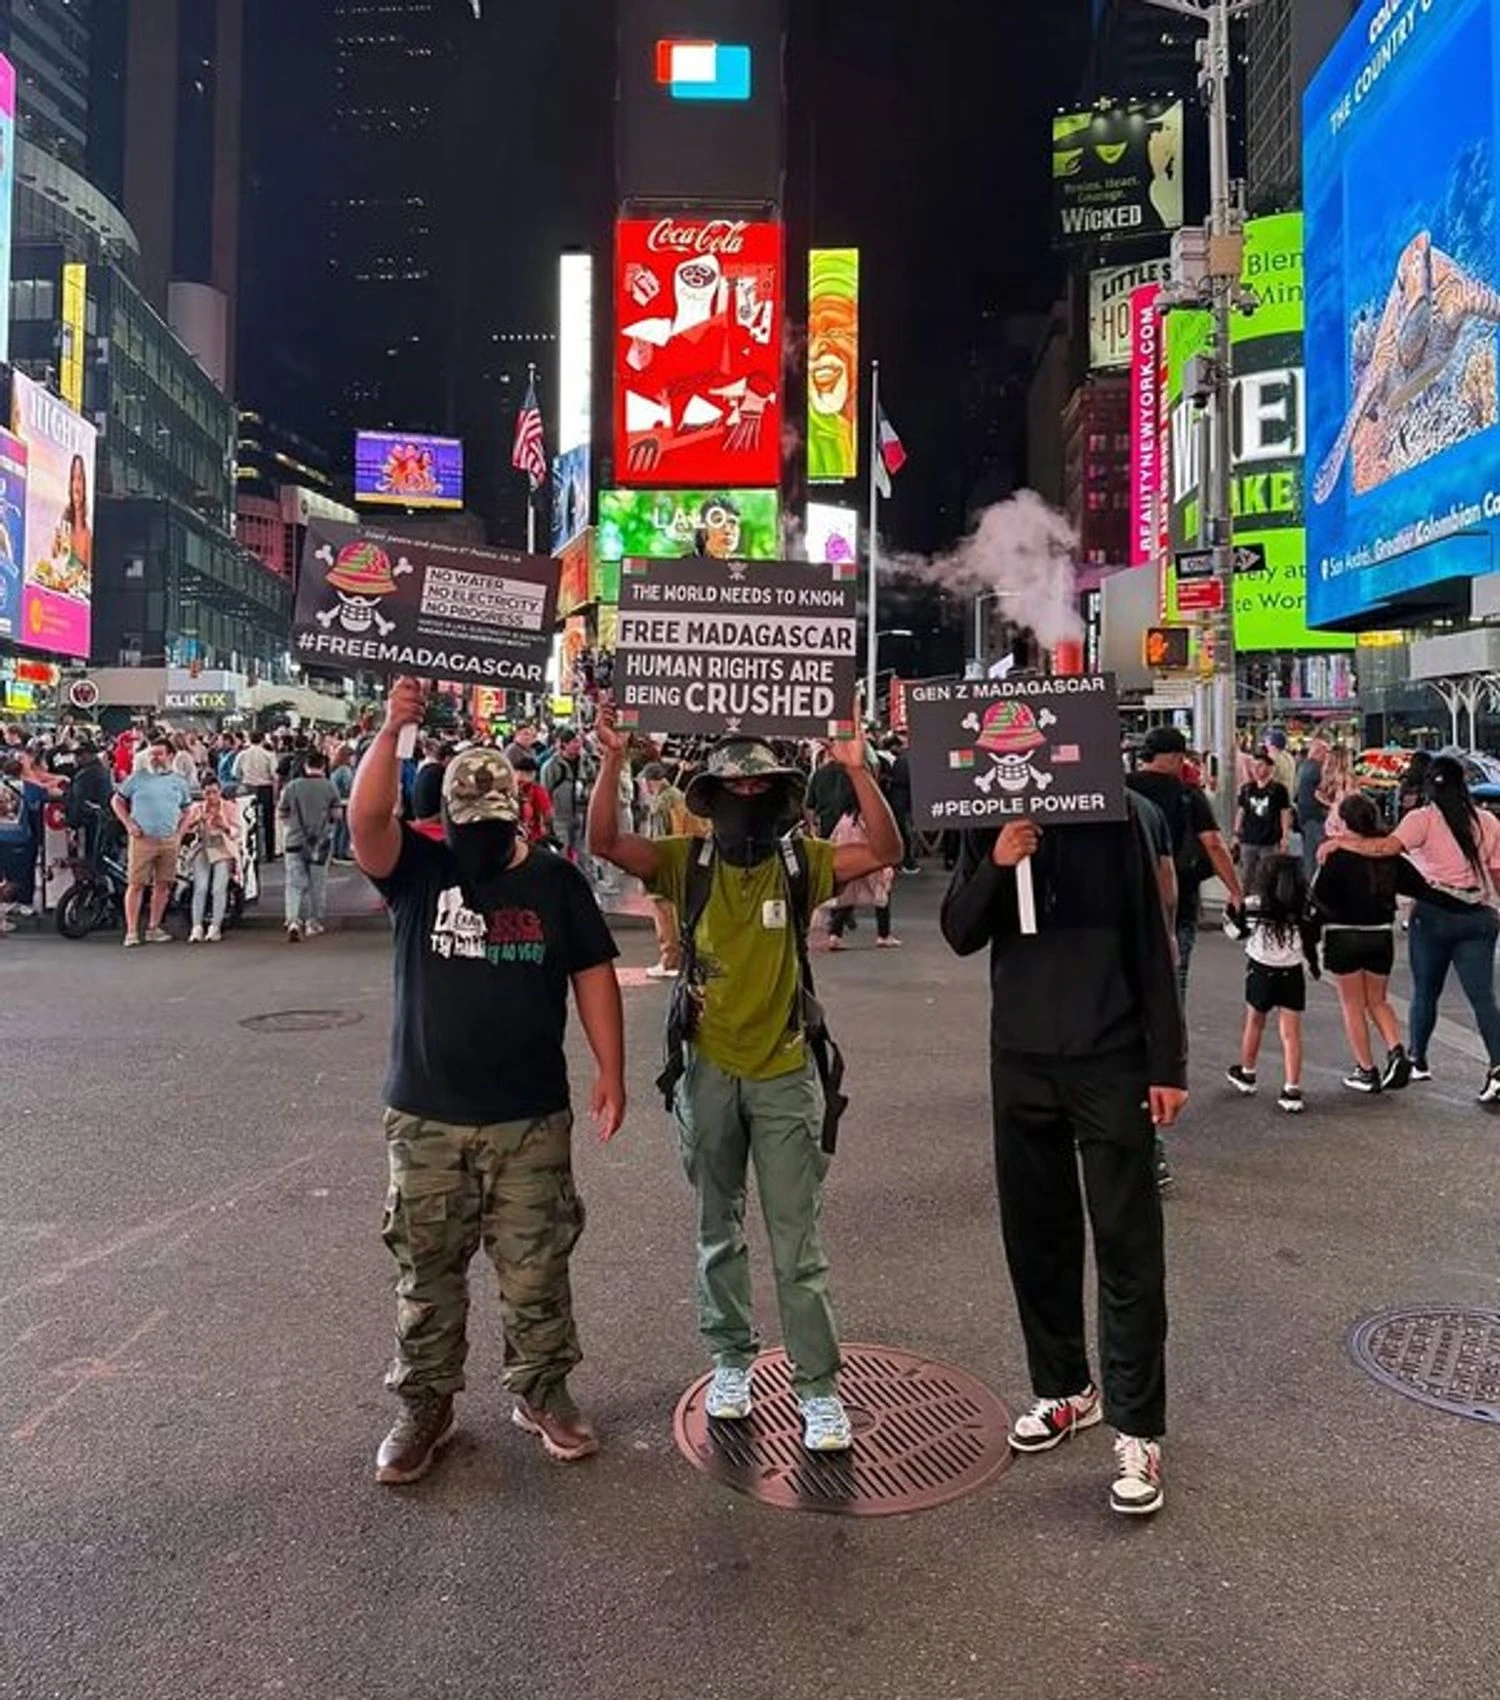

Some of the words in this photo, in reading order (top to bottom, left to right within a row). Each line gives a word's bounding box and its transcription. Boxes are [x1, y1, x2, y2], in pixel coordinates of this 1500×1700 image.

[1330, 91, 1352, 136] THE
[1355, 0, 1417, 104] COUNTRY
[430, 569, 453, 582] NO
[455, 572, 505, 590] WATER
[427, 585, 449, 599] NO
[451, 589, 539, 611] ELECTRICITY
[632, 584, 661, 600] THE
[663, 584, 718, 602] WORLD
[720, 586, 772, 604] NEEDS
[774, 588, 796, 605] TO
[798, 589, 845, 607] KNOW
[425, 600, 448, 614] NO
[449, 604, 524, 626] PROGRESS
[621, 619, 681, 643] FREE
[686, 620, 852, 651] MADAGASCAR
[297, 631, 542, 682] #FREEMADAGASCAR
[626, 653, 703, 678] HUMAN
[707, 656, 784, 681] RIGHTS
[789, 659, 835, 683] ARE
[165, 692, 227, 708] KLIKTIX
[625, 684, 681, 706] BEING
[684, 681, 835, 718] CRUSHED
[912, 685, 951, 702] GEN
[954, 684, 969, 699] Z
[973, 677, 1106, 699] MADAGASCAR
[930, 799, 1025, 818] #PEOPLE
[1030, 793, 1106, 812] POWER
